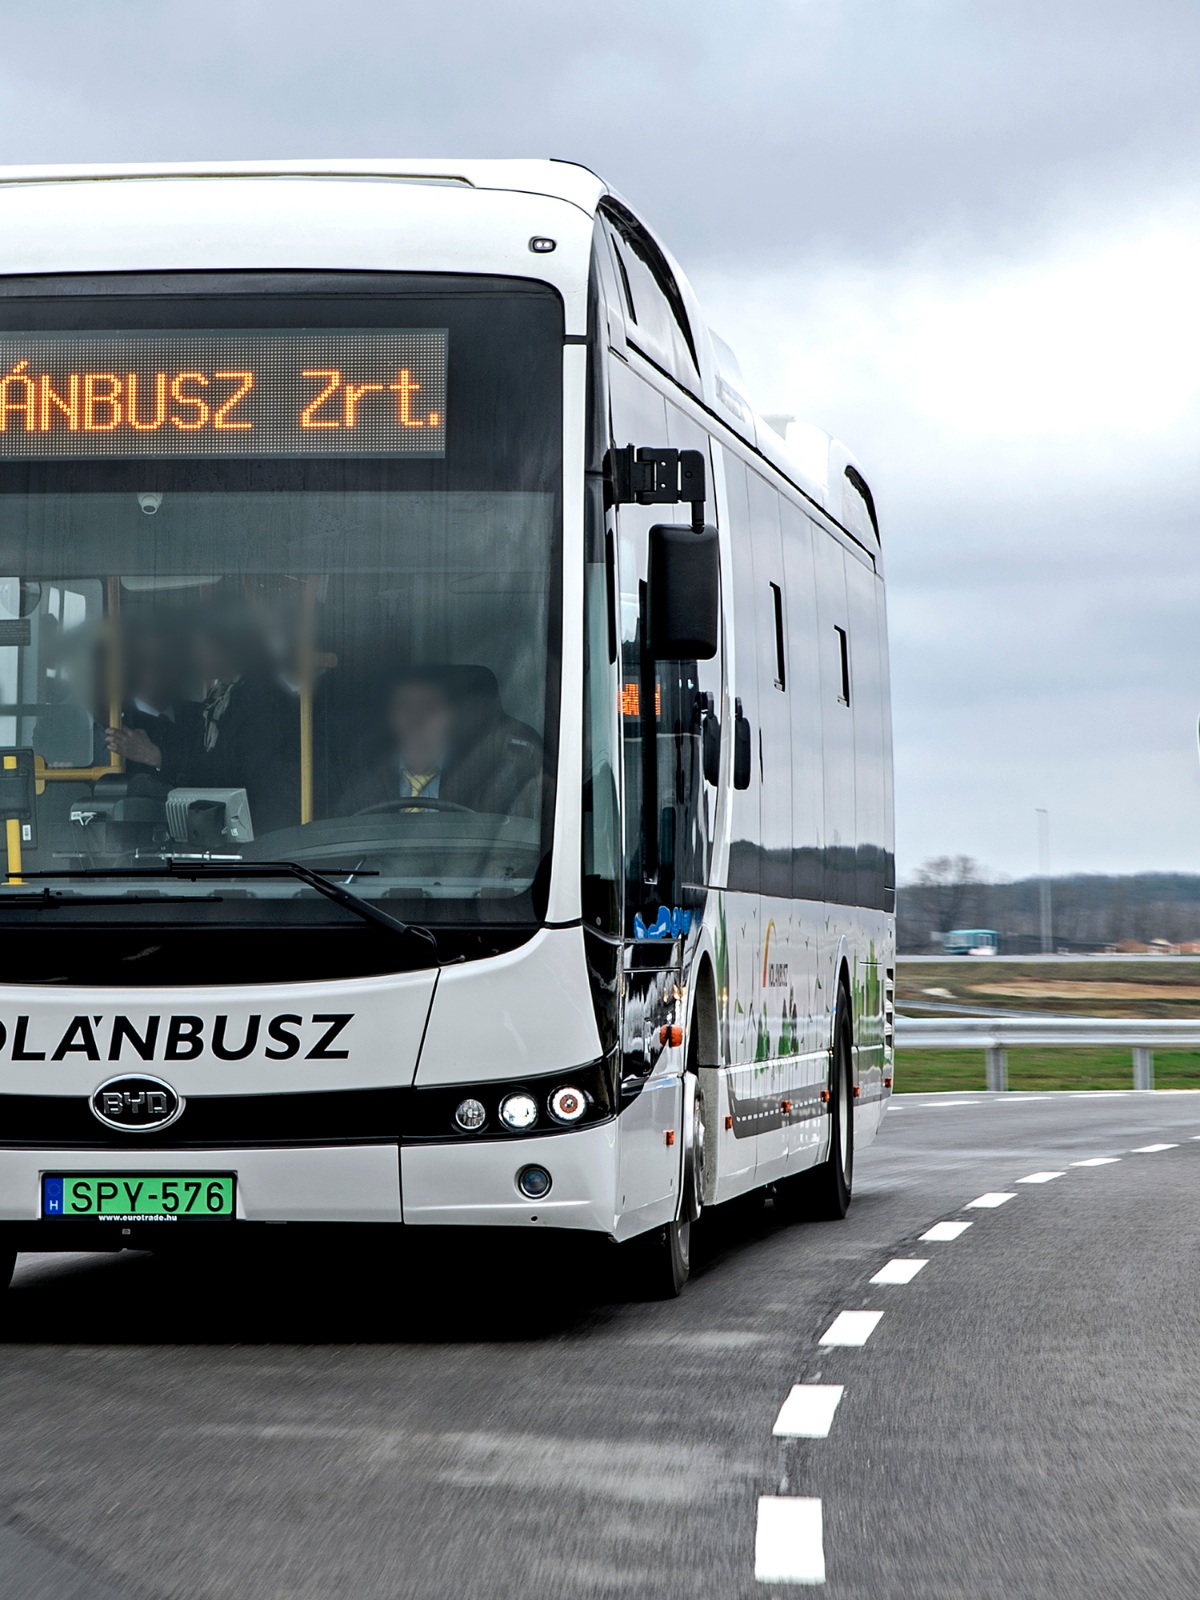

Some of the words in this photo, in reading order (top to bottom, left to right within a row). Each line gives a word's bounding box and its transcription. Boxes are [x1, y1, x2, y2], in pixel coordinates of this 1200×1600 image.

[301, 368, 440, 428] Zrt.
[102, 1091, 167, 1114] BYD
[50, 1200, 59, 1211] H
[71, 1181, 224, 1213] SPY-576
[98, 1214, 178, 1222] www.eurotrade.hu
